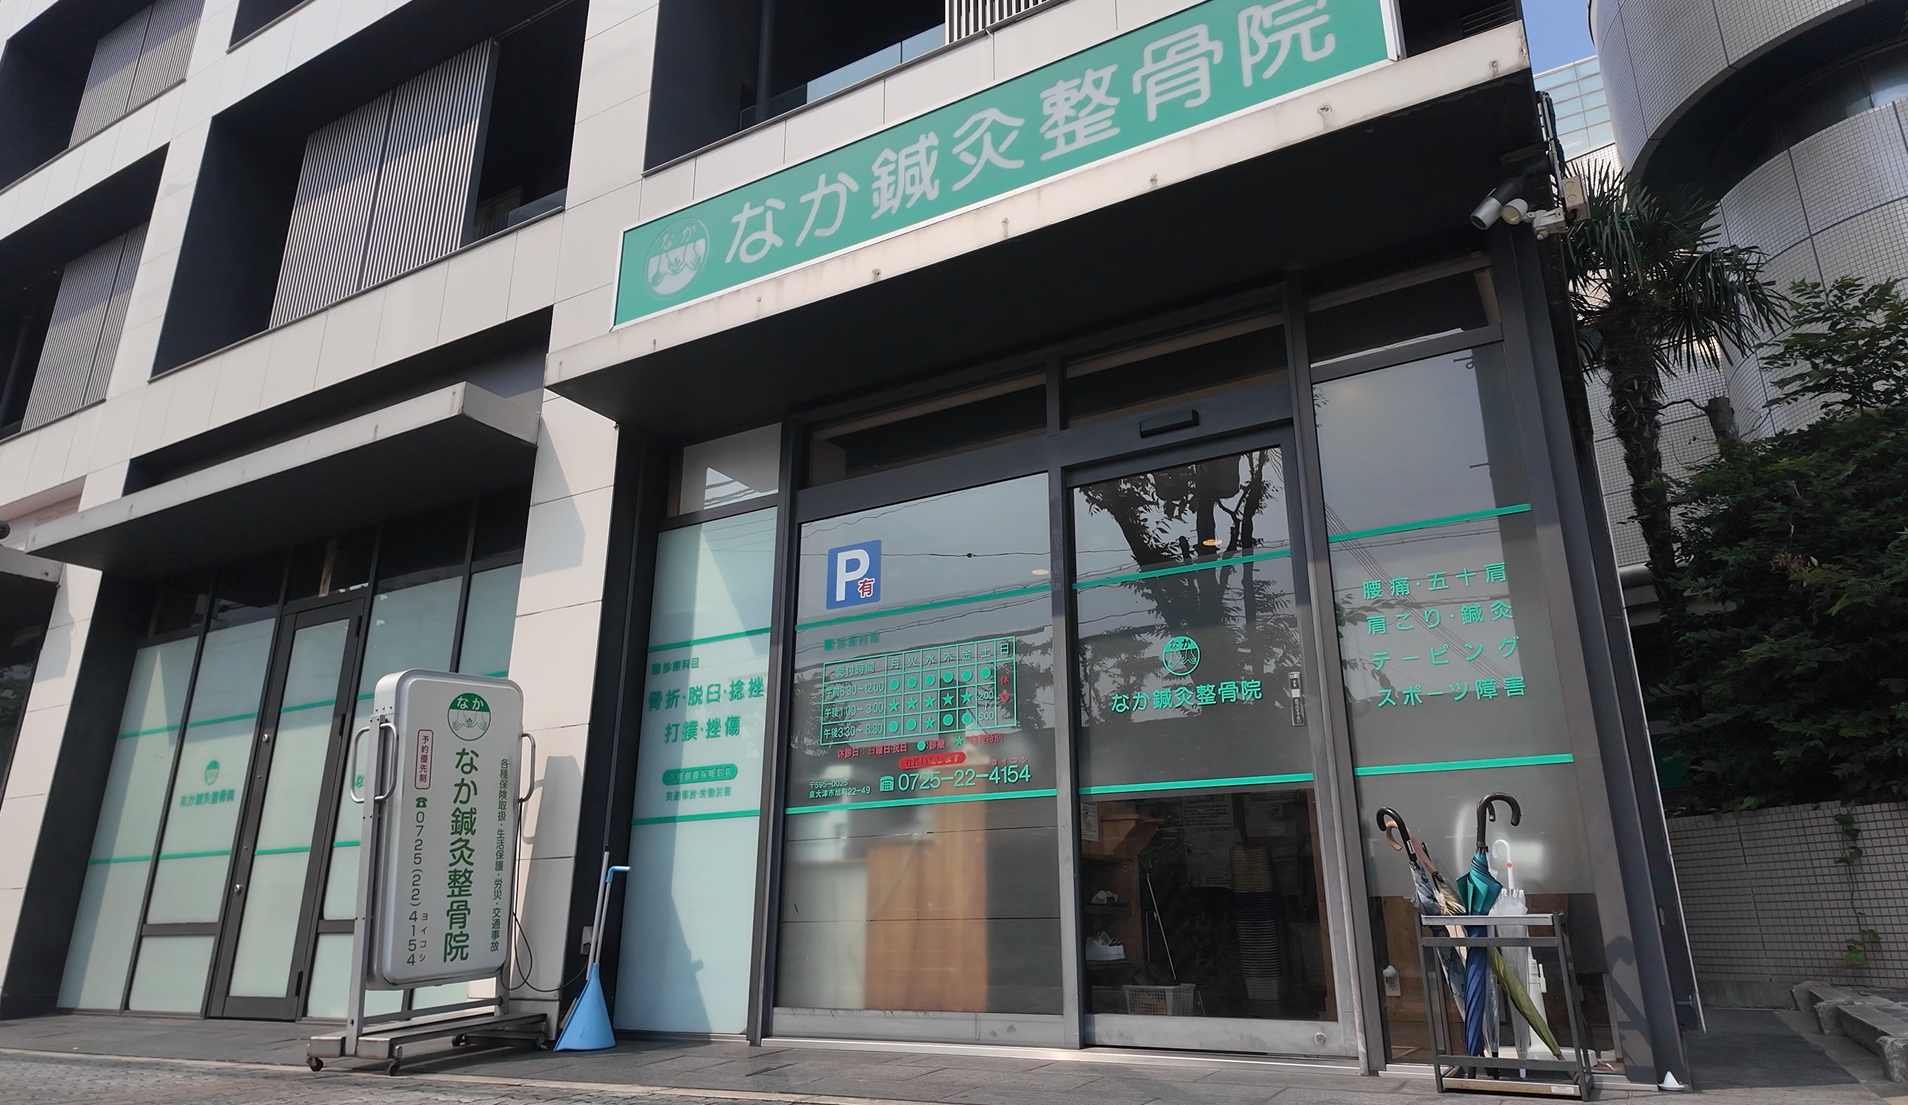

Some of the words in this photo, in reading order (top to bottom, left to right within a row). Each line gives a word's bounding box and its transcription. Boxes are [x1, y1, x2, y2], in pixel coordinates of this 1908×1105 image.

[724, 0, 1337, 265] なか鍼灸整骨院
[658, 222, 697, 251] なか
[836, 549, 870, 601] P
[1362, 561, 1507, 600] 腰痛・五十肩
[858, 578, 875, 597] 有
[1366, 600, 1513, 635] 肩こり・鍼灸
[981, 646, 991, 658] 土
[1000, 643, 1009, 655] 日
[1169, 638, 1192, 649] なか
[1371, 635, 1520, 671] テーピング
[890, 657, 900, 670] 月
[907, 657, 917, 667] 火
[925, 654, 935, 665] 水
[943, 651, 953, 662] 木
[962, 648, 972, 660] 金
[663, 657, 700, 674] 診療科目
[835, 661, 875, 678] 受付時間
[1110, 679, 1262, 713] なか鍼灸整骨院
[1377, 676, 1526, 708] スポーツ障害
[457, 698, 484, 711] なか
[418, 735, 430, 783] 予約優先制
[898, 765, 1031, 791] 0725-22-4154
[443, 747, 480, 963] なか鍼灸整骨院
